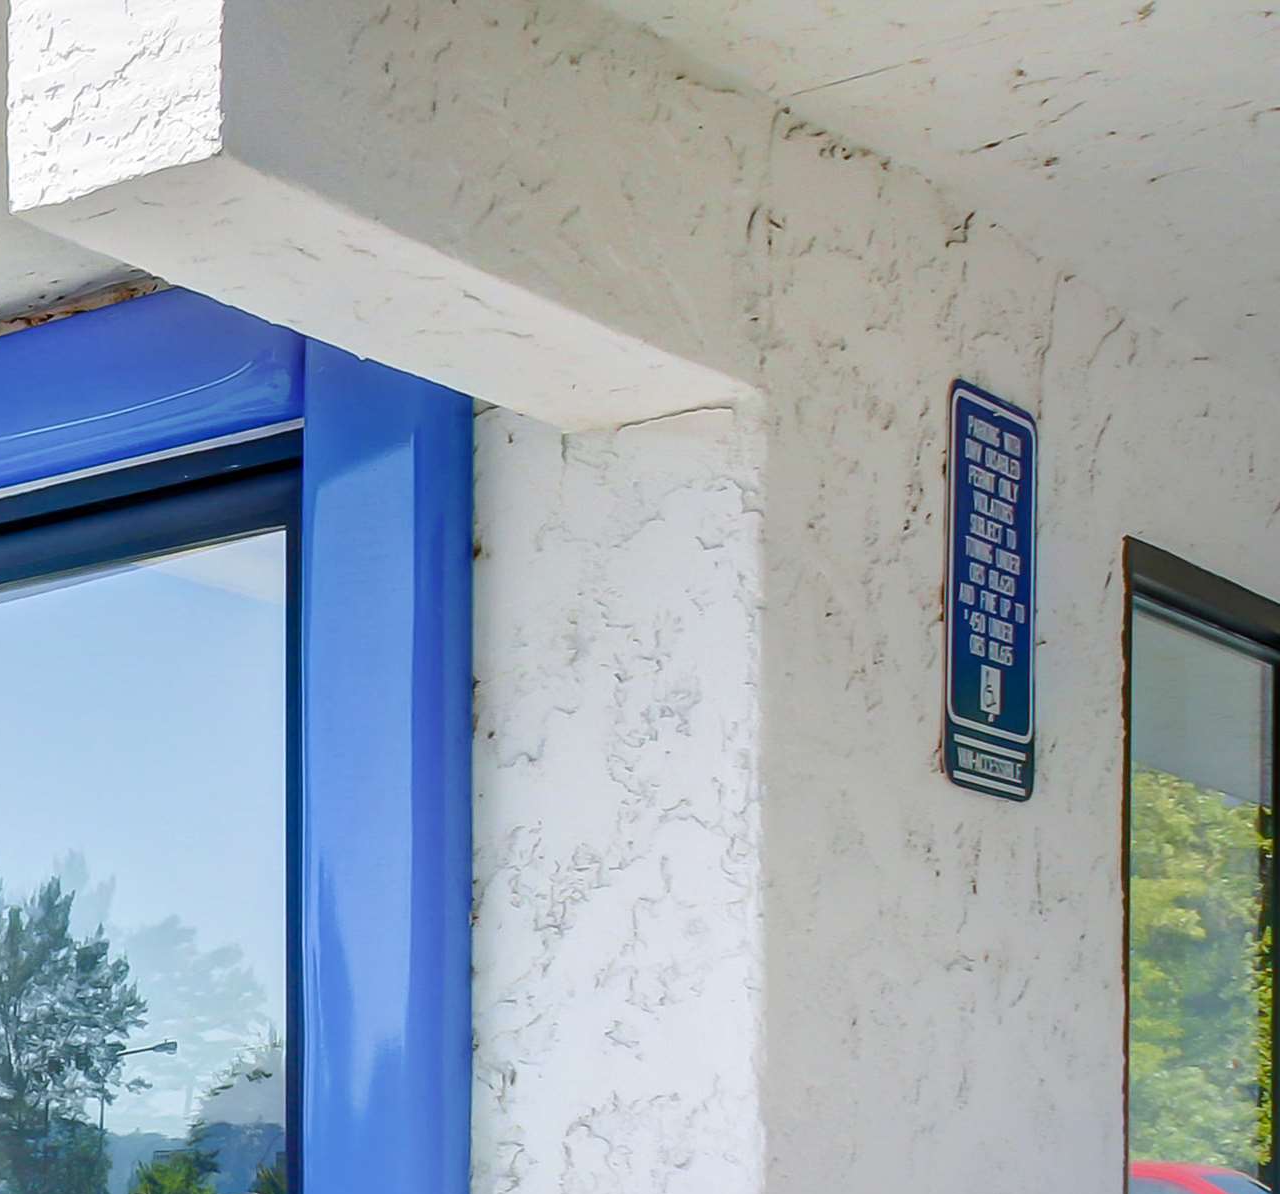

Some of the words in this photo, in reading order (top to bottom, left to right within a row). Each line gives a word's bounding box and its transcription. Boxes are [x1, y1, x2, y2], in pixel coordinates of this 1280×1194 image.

[967, 415, 1001, 448] PARKING
[984, 446, 1021, 481] DISABLED
[968, 464, 996, 494] PERMIT
[998, 477, 1020, 504] ONLY
[969, 513, 1004, 545] SUBJECT
[1006, 528, 1017, 550] TO
[995, 547, 1021, 576] UNDER
[958, 582, 976, 606] AND
[980, 589, 998, 615] FINE
[1000, 597, 1012, 619] UP
[1014, 602, 1025, 625] TO
[988, 616, 1014, 645] UNDER
